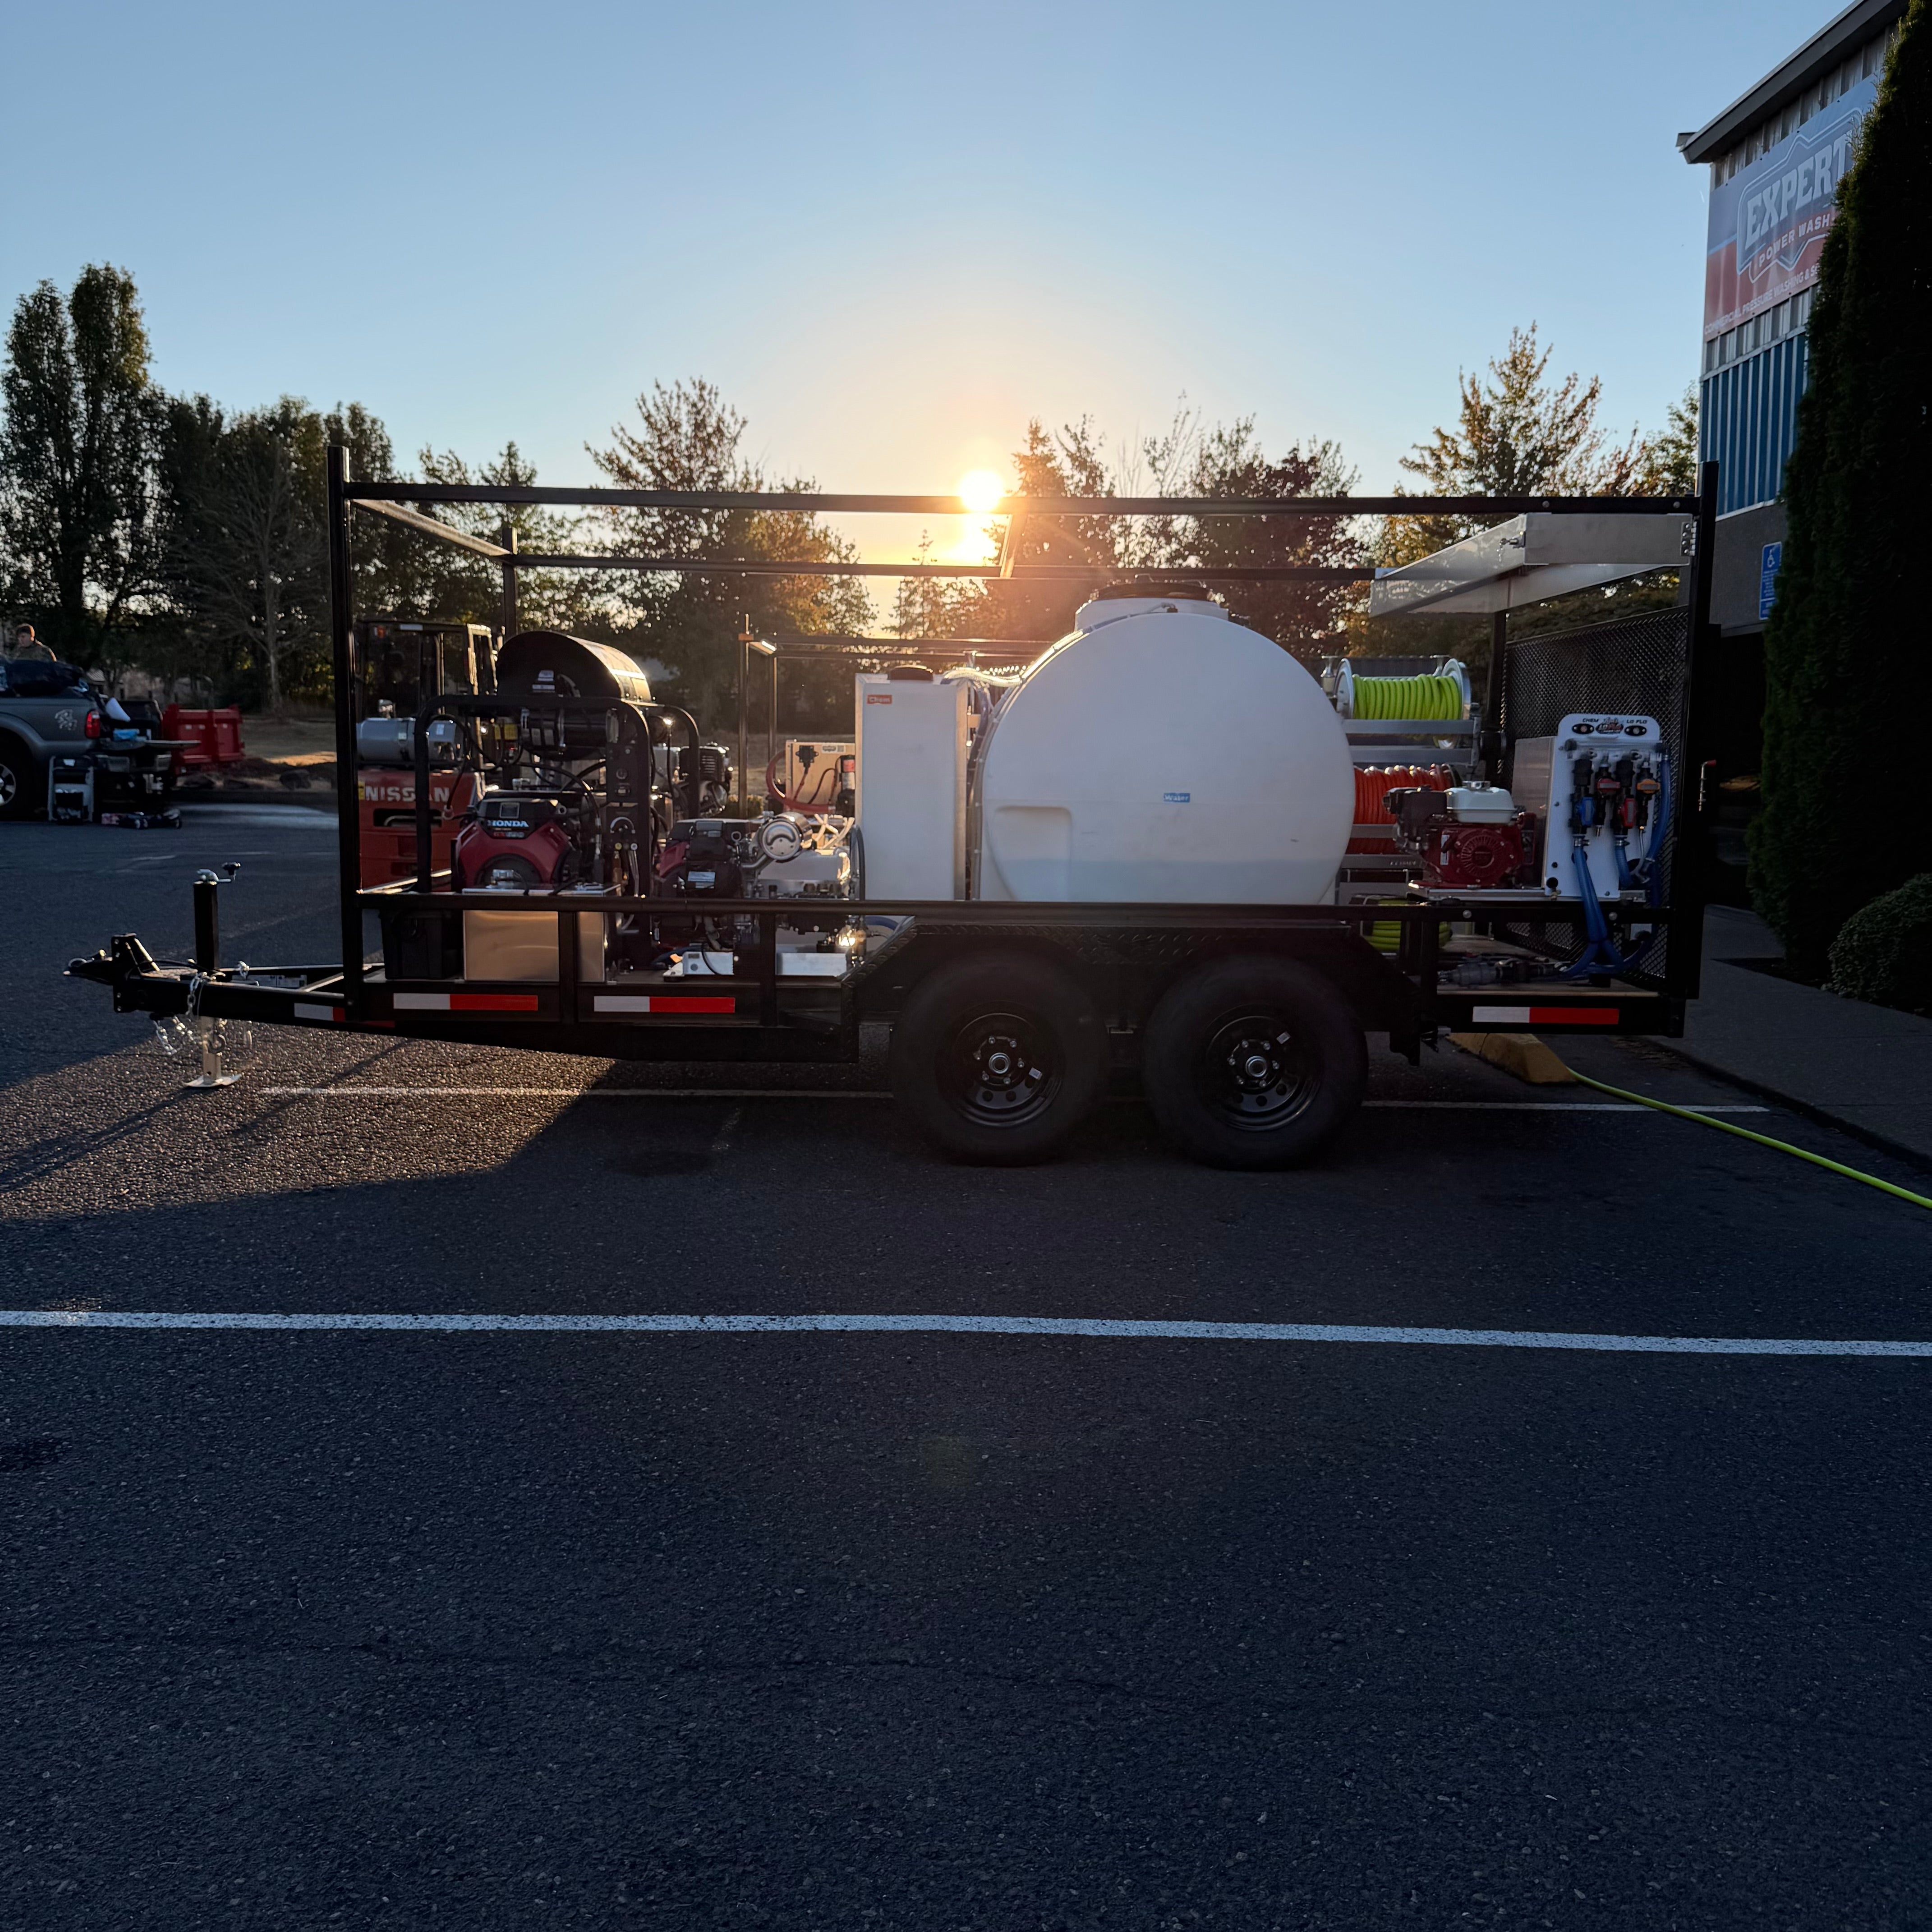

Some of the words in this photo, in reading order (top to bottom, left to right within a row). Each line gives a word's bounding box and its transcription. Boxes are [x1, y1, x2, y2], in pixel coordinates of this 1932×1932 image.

[1745, 135, 1851, 250] EXPERT
[1759, 230, 1795, 267] POWER
[1742, 288, 1773, 315] PRESSURE
[1773, 271, 1804, 298] WASHING
[1804, 268, 1810, 281] &
